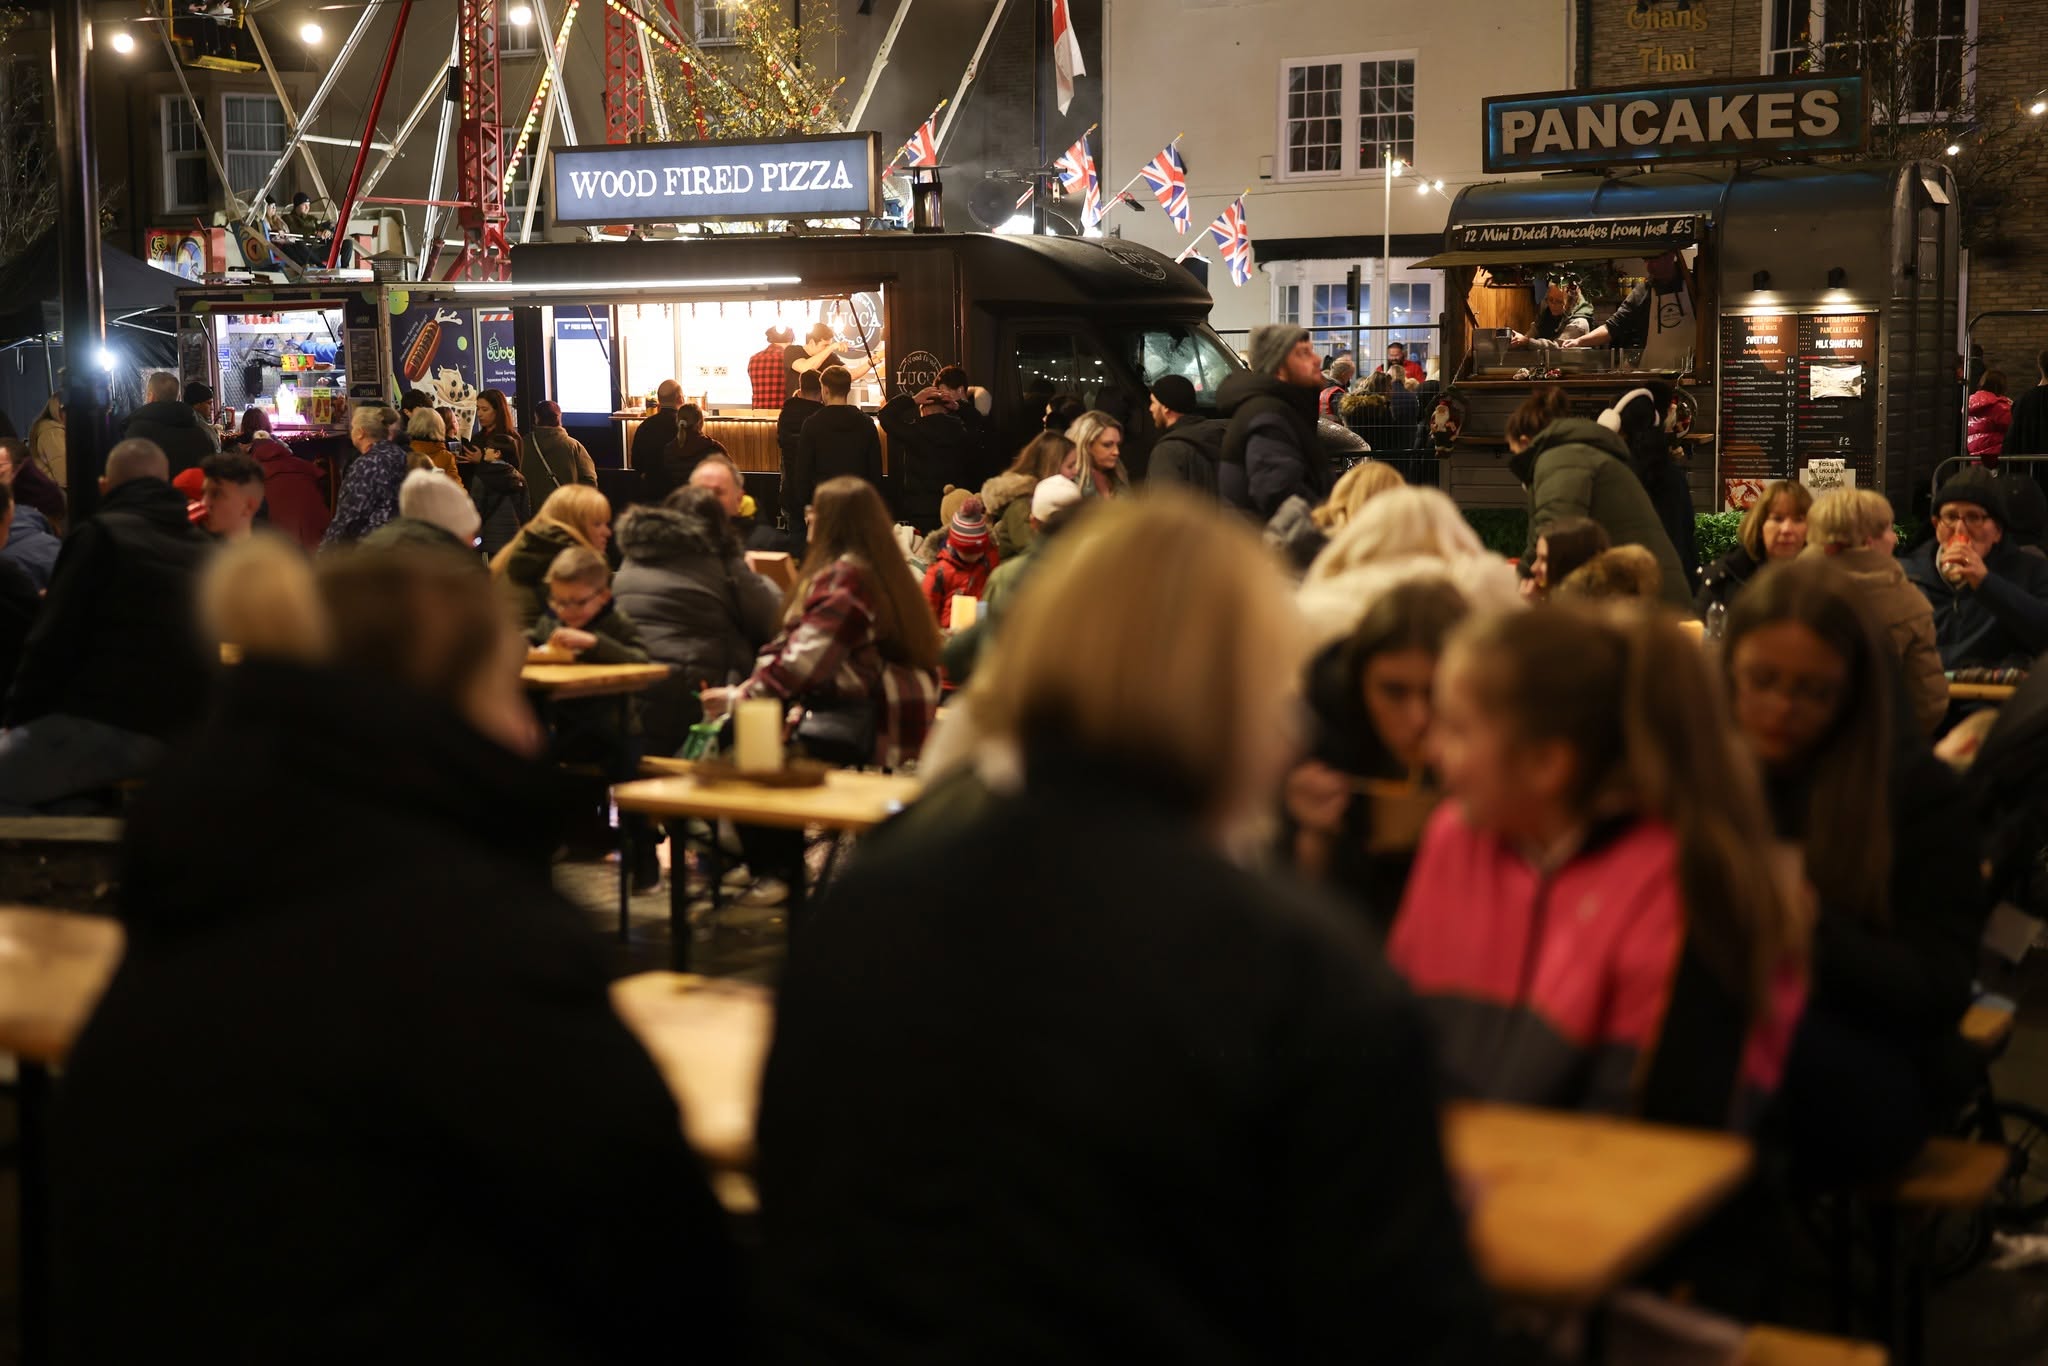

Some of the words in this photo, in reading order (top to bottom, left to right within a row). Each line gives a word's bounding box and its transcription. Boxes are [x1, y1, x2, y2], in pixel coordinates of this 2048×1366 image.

[1625, 5, 1709, 32] Chang
[1639, 46, 1696, 73] Thai
[1502, 89, 1840, 155] PANCAKES
[569, 169, 657, 200] WOOD
[663, 164, 753, 196] FIRED
[760, 159, 853, 193] PIZZA
[1465, 229, 1477, 242] 12
[1479, 228, 1510, 241] Mini
[1512, 225, 1548, 240] Dutch
[1550, 224, 1608, 240] Pancakes
[1610, 222, 1640, 240] from
[1644, 220, 1669, 238] just
[1671, 219, 1693, 234] £5
[826, 311, 882, 328] LUCCA
[1746, 335, 1763, 344] SWEET
[1763, 335, 1779, 344] MENU
[1815, 339, 1829, 349] MILK
[1829, 339, 1847, 348] SHAKE
[1847, 338, 1863, 348] MENU
[923, 354, 937, 368] fied
[896, 371, 937, 386] LUCC
